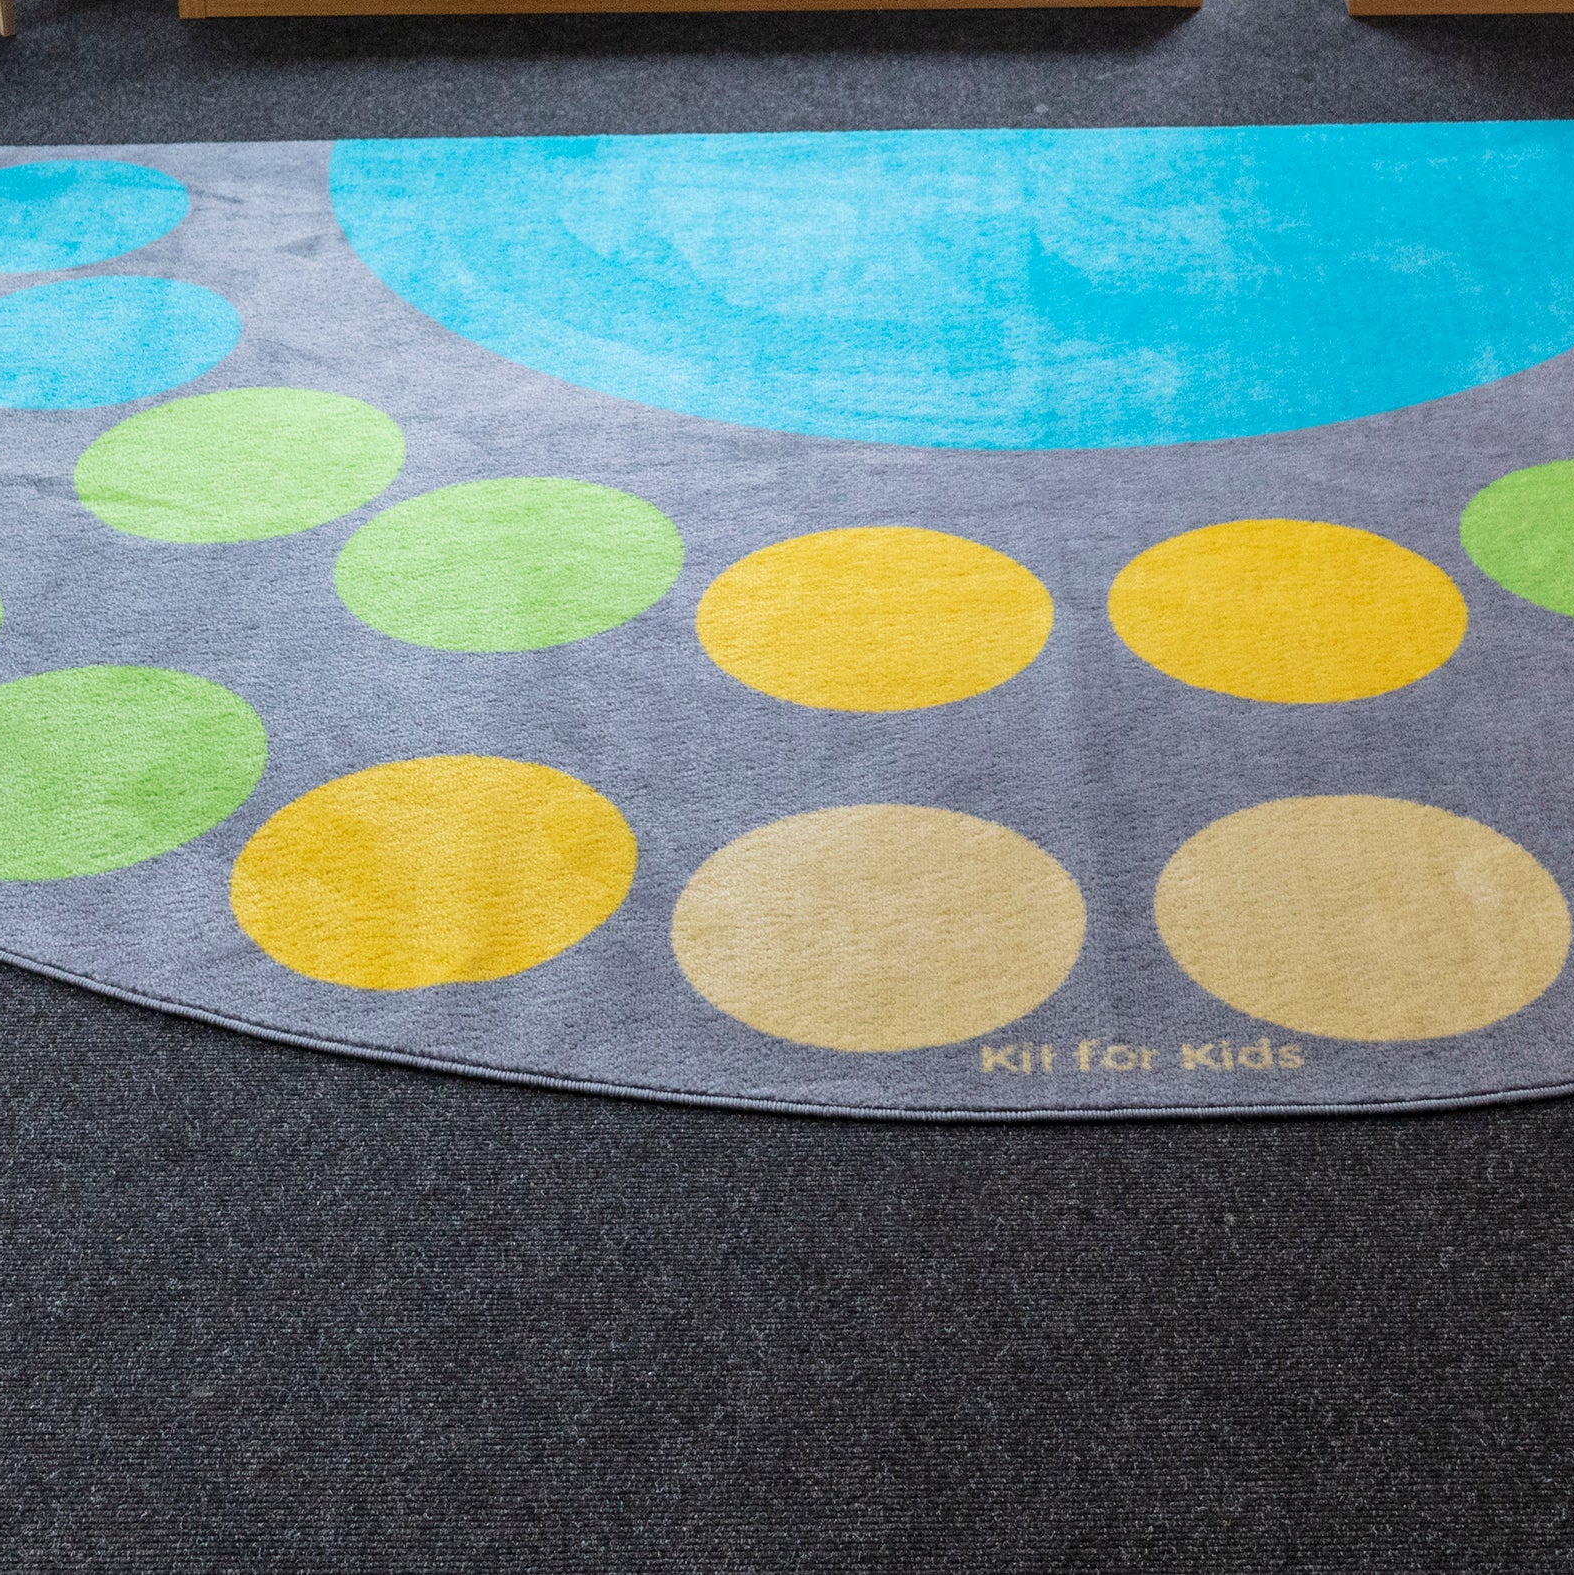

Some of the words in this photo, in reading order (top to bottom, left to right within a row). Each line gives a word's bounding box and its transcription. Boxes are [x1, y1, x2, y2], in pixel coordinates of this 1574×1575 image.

[981, 1040, 1057, 1074] Kit
[1073, 1038, 1161, 1073] for
[1182, 1036, 1305, 1071] Kids
